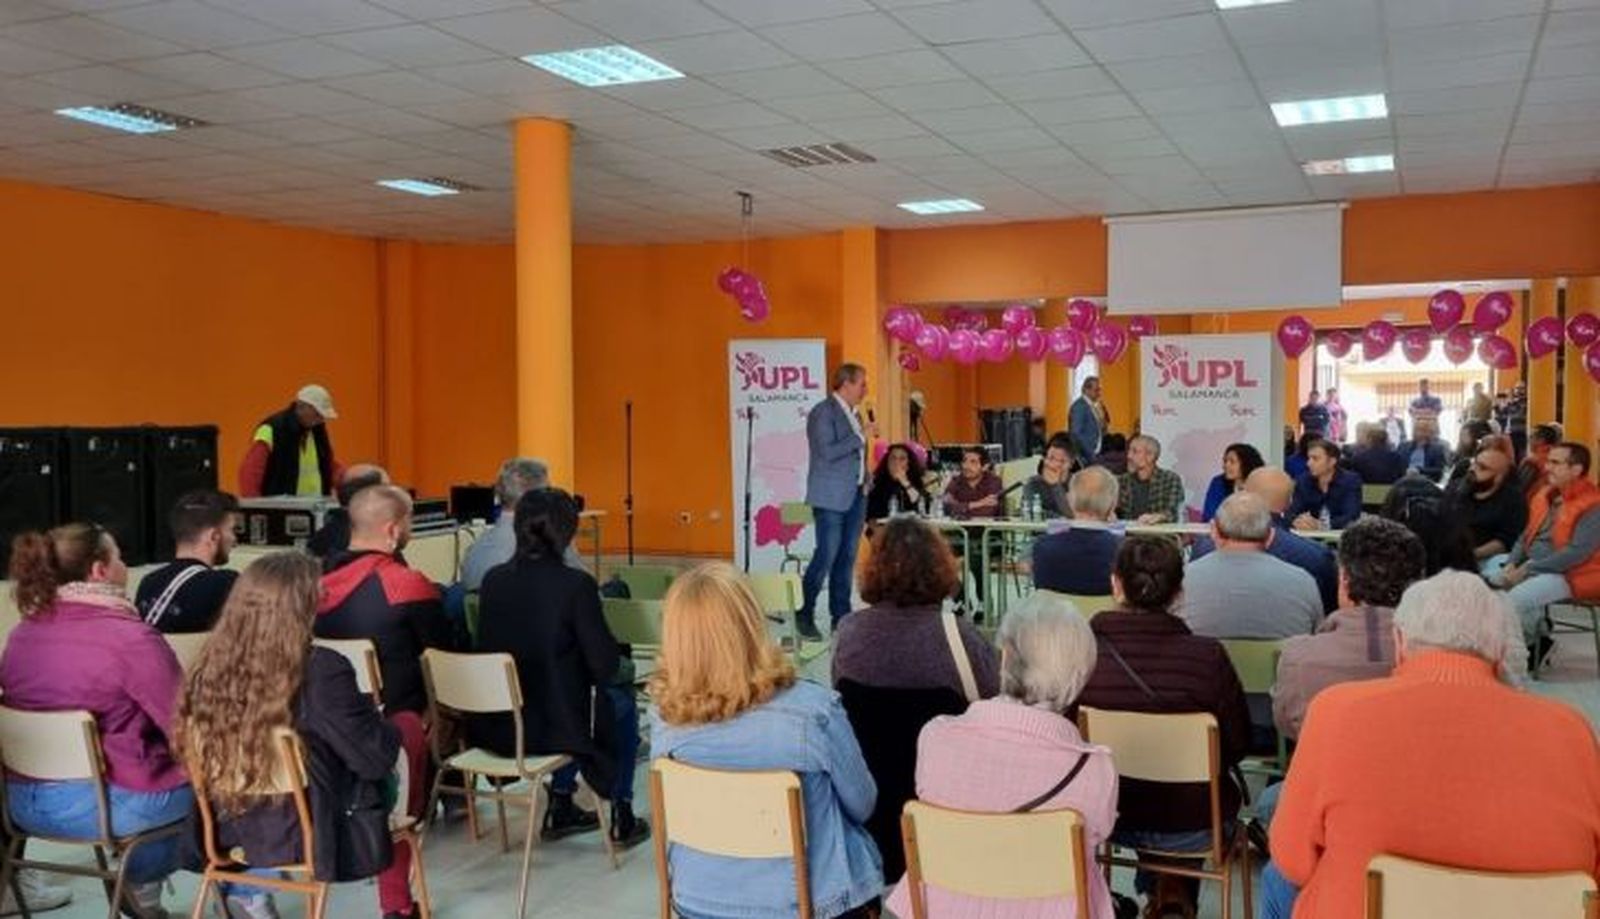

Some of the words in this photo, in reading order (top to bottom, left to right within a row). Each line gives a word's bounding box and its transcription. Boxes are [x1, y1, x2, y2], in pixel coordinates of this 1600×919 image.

[757, 367, 819, 390] UPL
[1178, 360, 1258, 388] UPL
[748, 393, 809, 403] SALAMANCA
[1168, 389, 1240, 399] SALAMANCA
